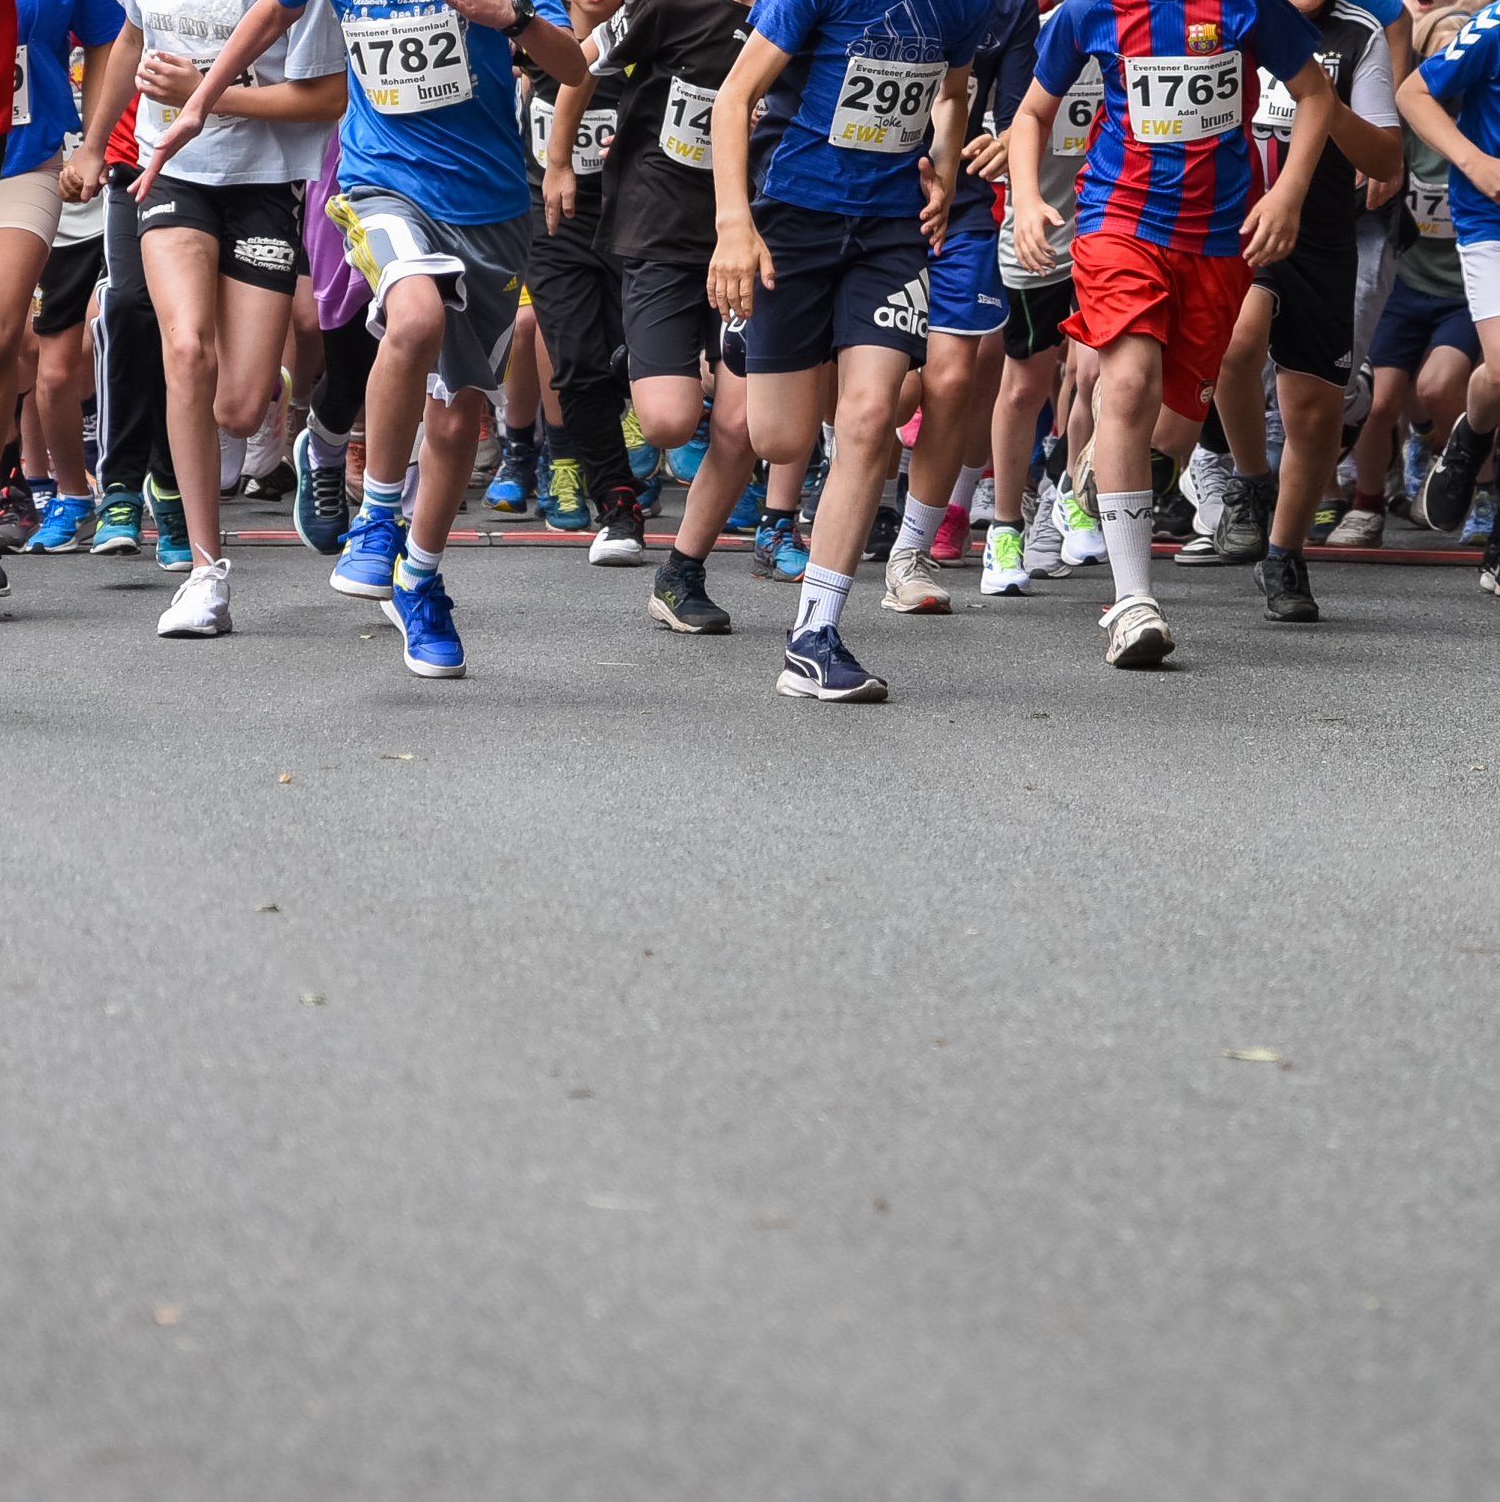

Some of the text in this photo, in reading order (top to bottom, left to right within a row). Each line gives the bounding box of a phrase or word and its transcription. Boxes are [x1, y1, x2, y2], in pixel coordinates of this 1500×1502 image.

[346, 20, 449, 38] Everstener Brunnenlauf
[350, 32, 461, 75] 1782
[1184, 57, 1234, 71] Brunnenlauf
[381, 75, 425, 85] Mohamed
[856, 64, 903, 78] Everstener
[366, 88, 399, 105] EWE
[417, 81, 459, 100] bruns
[841, 76, 938, 116] 2981
[1132, 66, 1239, 107] 1765
[842, 123, 888, 144] EWE
[1141, 120, 1183, 135] EWE
[1201, 111, 1234, 129] bruns
[667, 135, 705, 161] EWE
